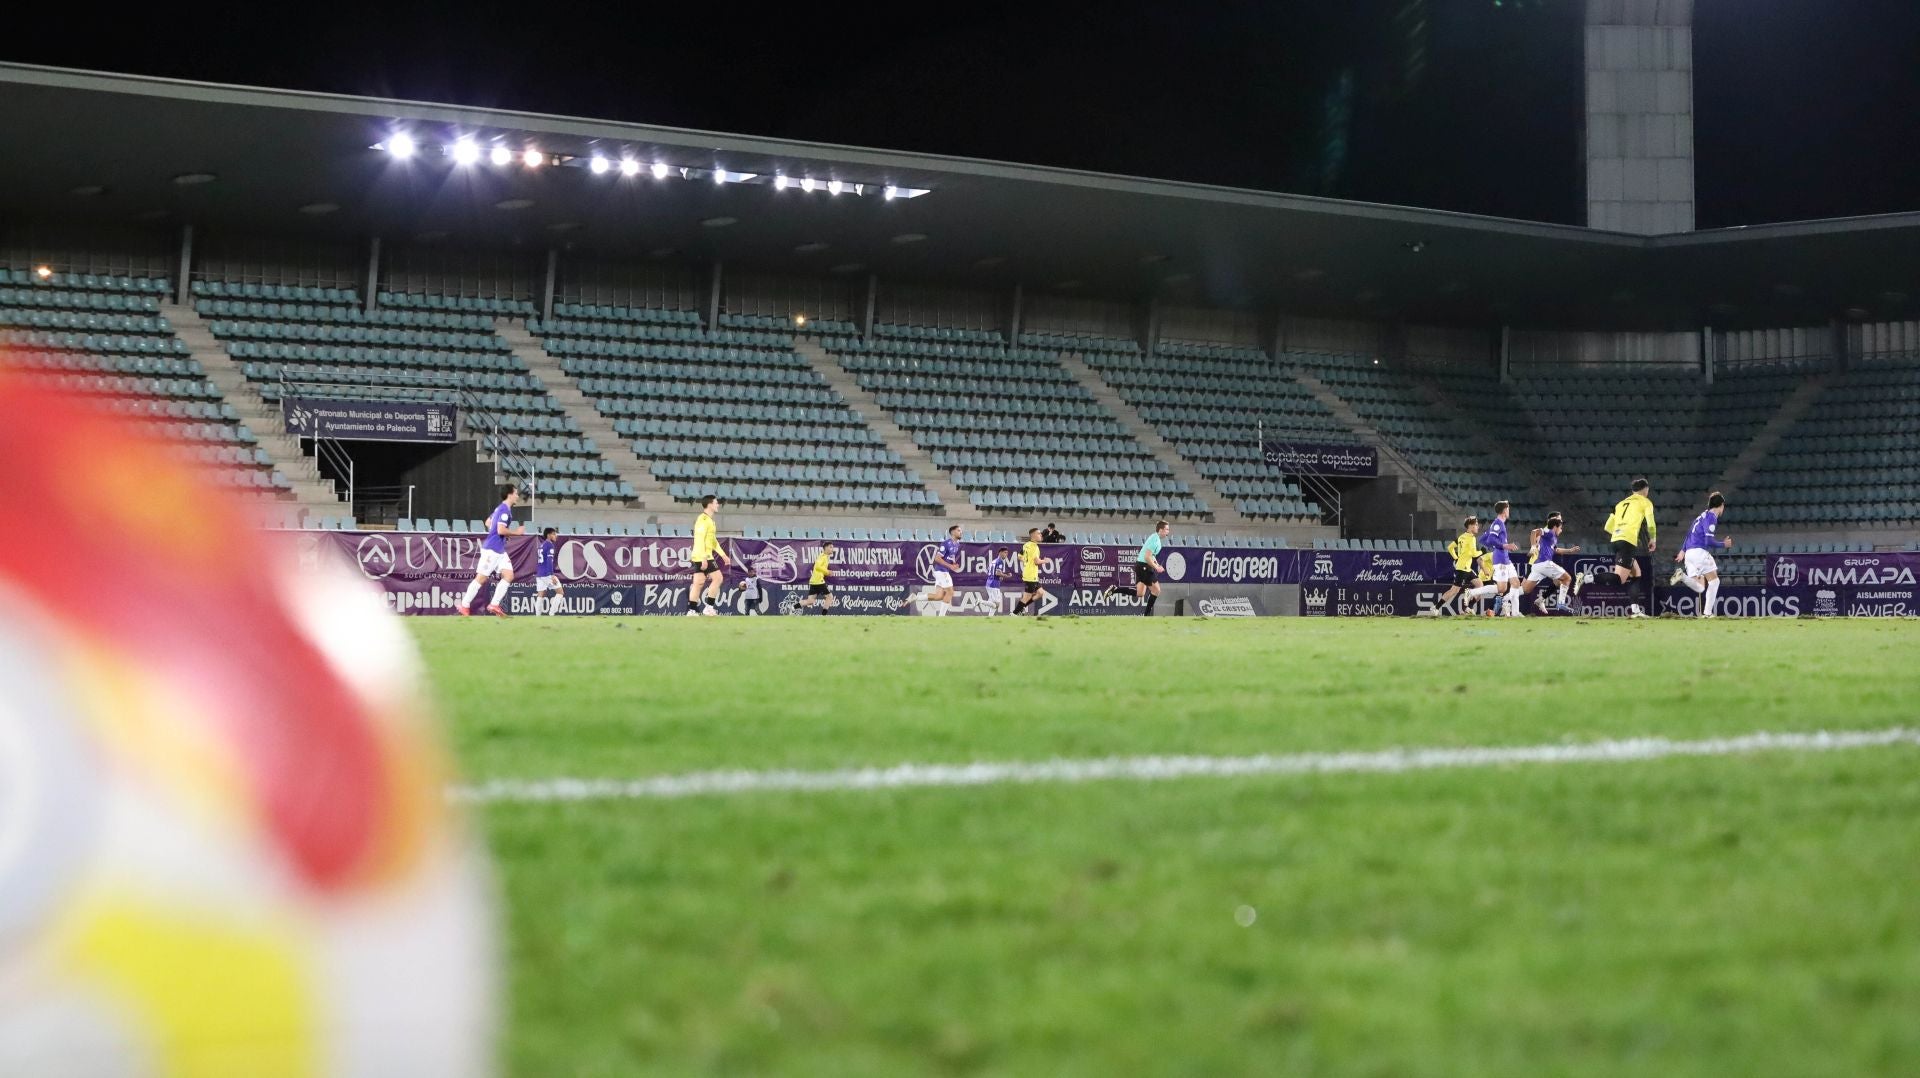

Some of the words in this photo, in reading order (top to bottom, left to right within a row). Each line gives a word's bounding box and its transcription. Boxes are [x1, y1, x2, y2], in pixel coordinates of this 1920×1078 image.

[313, 408, 348, 419] Patronato
[349, 411, 382, 420] Municipal
[384, 412, 394, 420] de
[394, 412, 426, 422] Deportes
[325, 421, 375, 431] Ayuntamiento
[376, 423, 386, 431] de
[386, 424, 417, 433] Palencia
[1266, 446, 1318, 467] copaboca
[1322, 449, 1372, 469] copaboca
[1622, 502, 1631, 520] 7
[615, 542, 692, 569] orteg
[848, 548, 904, 565] INDUSTRIAL
[1083, 550, 1103, 560] Sam
[1372, 554, 1404, 569] Seguros
[1002, 551, 1064, 575] Mor
[1201, 551, 1278, 583] fibergreen
[664, 573, 693, 581] industr
[1391, 570, 1424, 582] Revilla
[1808, 567, 1917, 585] INMAPA
[644, 584, 686, 609] Bar
[1337, 588, 1393, 601] Hotel
[1856, 591, 1913, 599] AISLAMIENTOS
[842, 595, 883, 612] Rodríguez
[1337, 604, 1353, 616] REY
[1354, 604, 1394, 616] SANCHO
[1581, 601, 1648, 617] palenca
[1847, 602, 1907, 617] JAVIER
